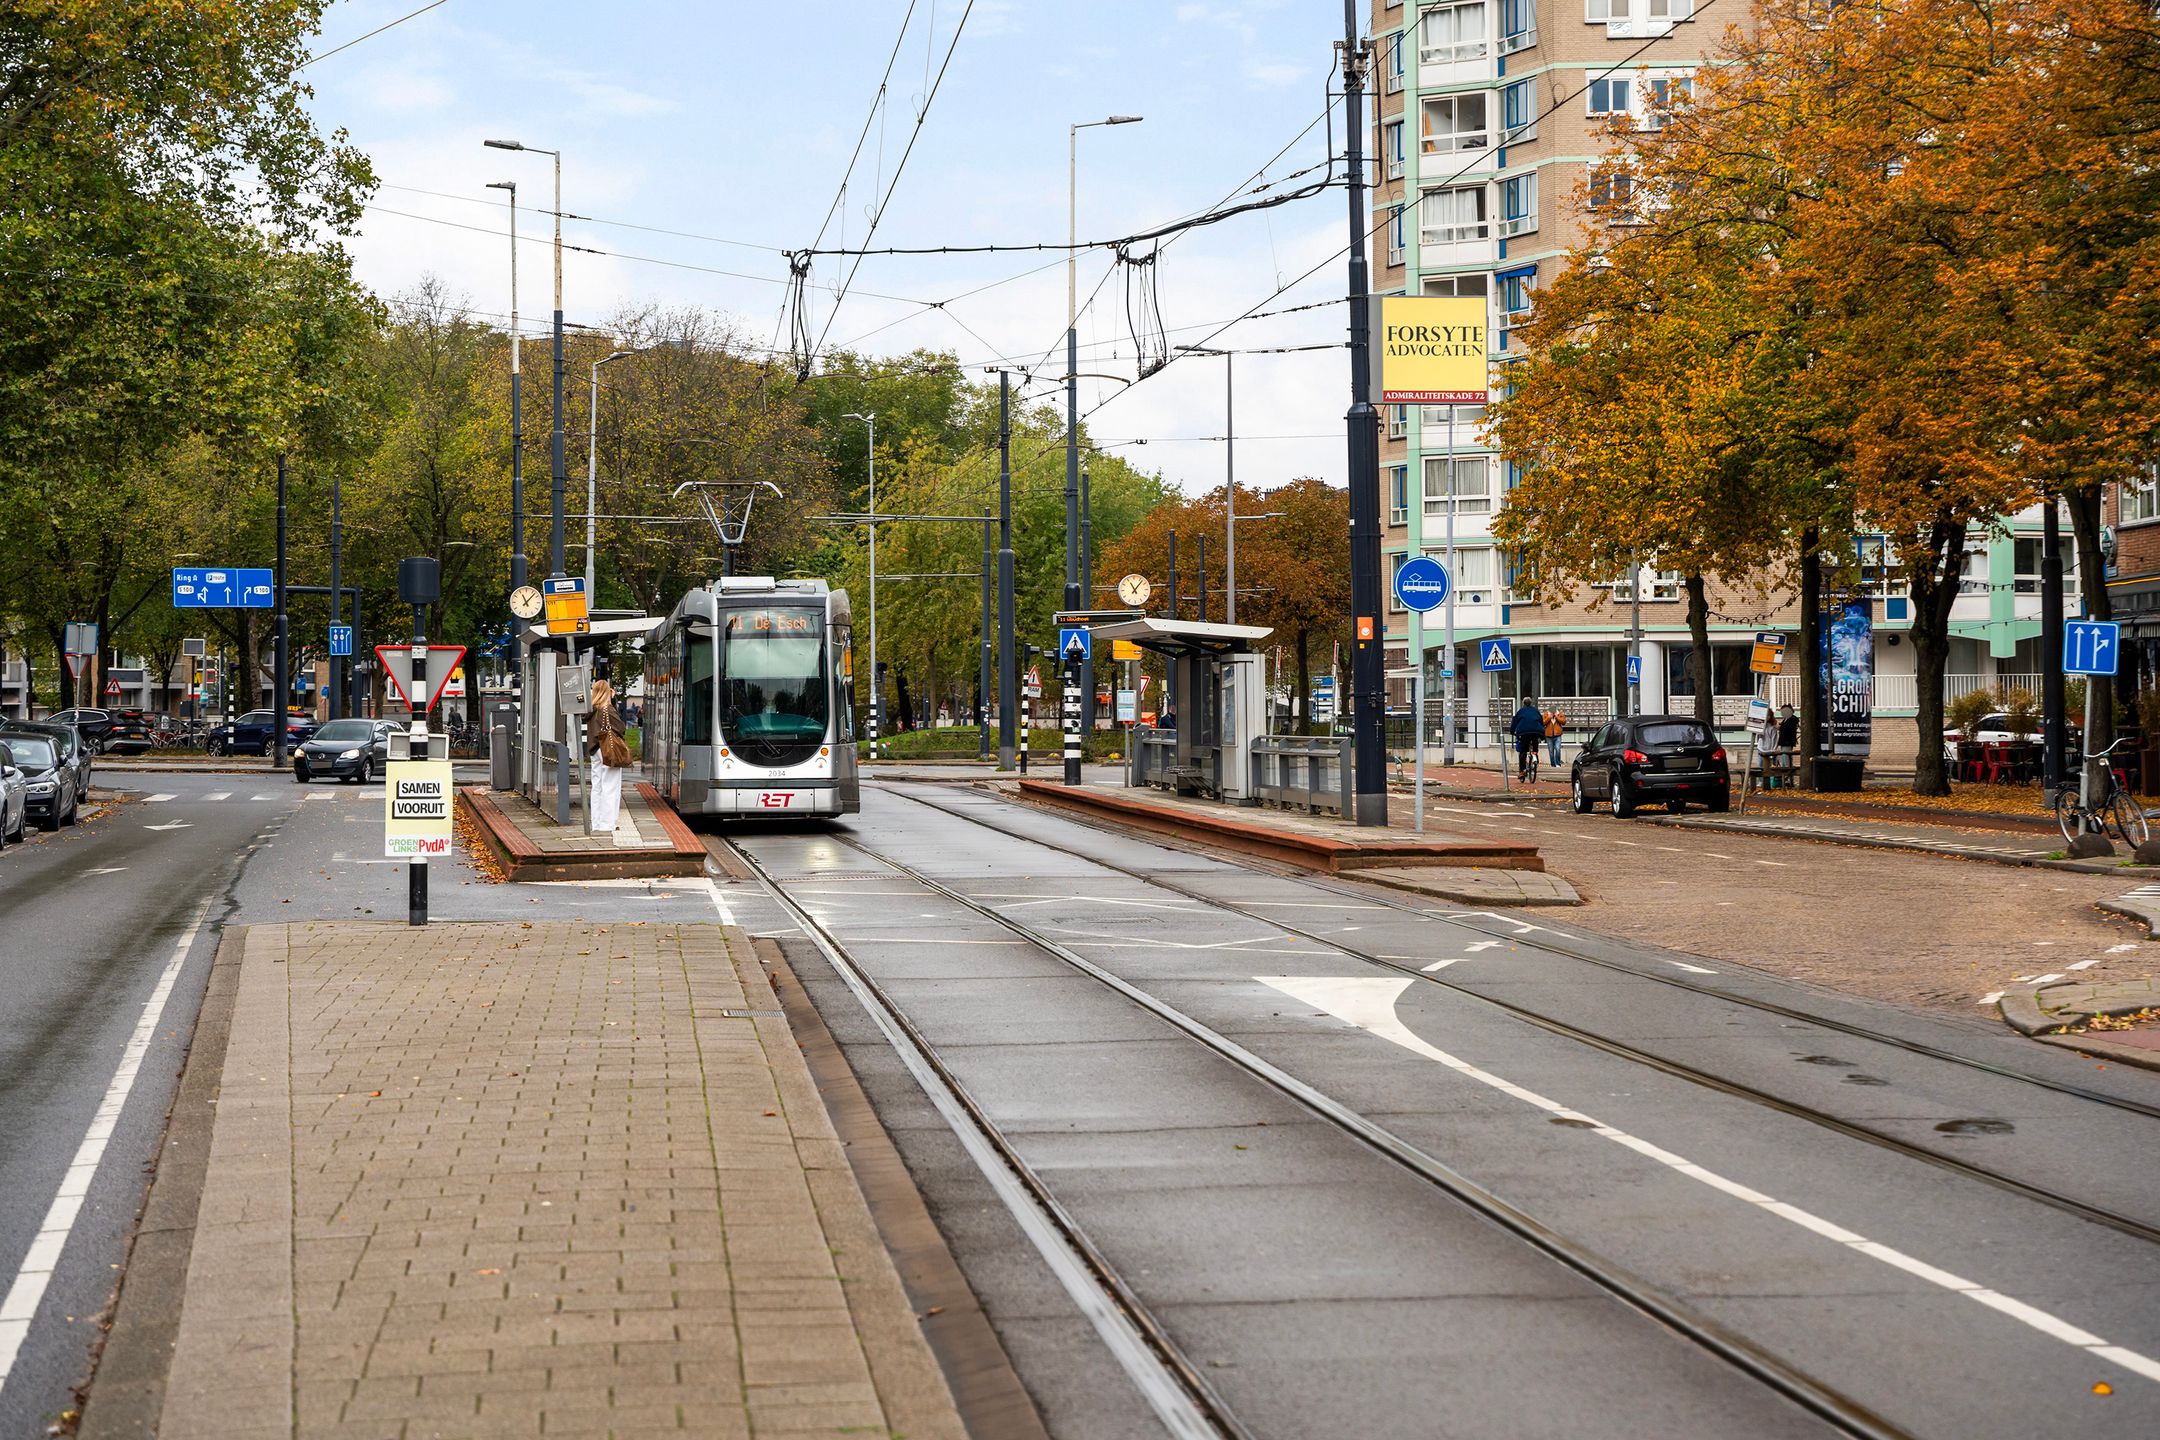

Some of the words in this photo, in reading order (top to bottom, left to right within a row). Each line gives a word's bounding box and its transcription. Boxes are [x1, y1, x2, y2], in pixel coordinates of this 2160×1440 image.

[1387, 325, 1484, 342] FORSYTE
[1386, 344, 1483, 356] ADVOCATEN
[1385, 391, 1473, 400] ADMIRALITEITSKADE
[1475, 391, 1485, 400] 72
[176, 574, 192, 583] Ring
[755, 615, 770, 630] De
[778, 615, 807, 630] Esch
[401, 782, 441, 794] SAMEN
[761, 793, 795, 807] RET
[397, 802, 445, 814] VOORUIT
[393, 845, 418, 853] LINKS
[418, 838, 445, 853] PvdA
